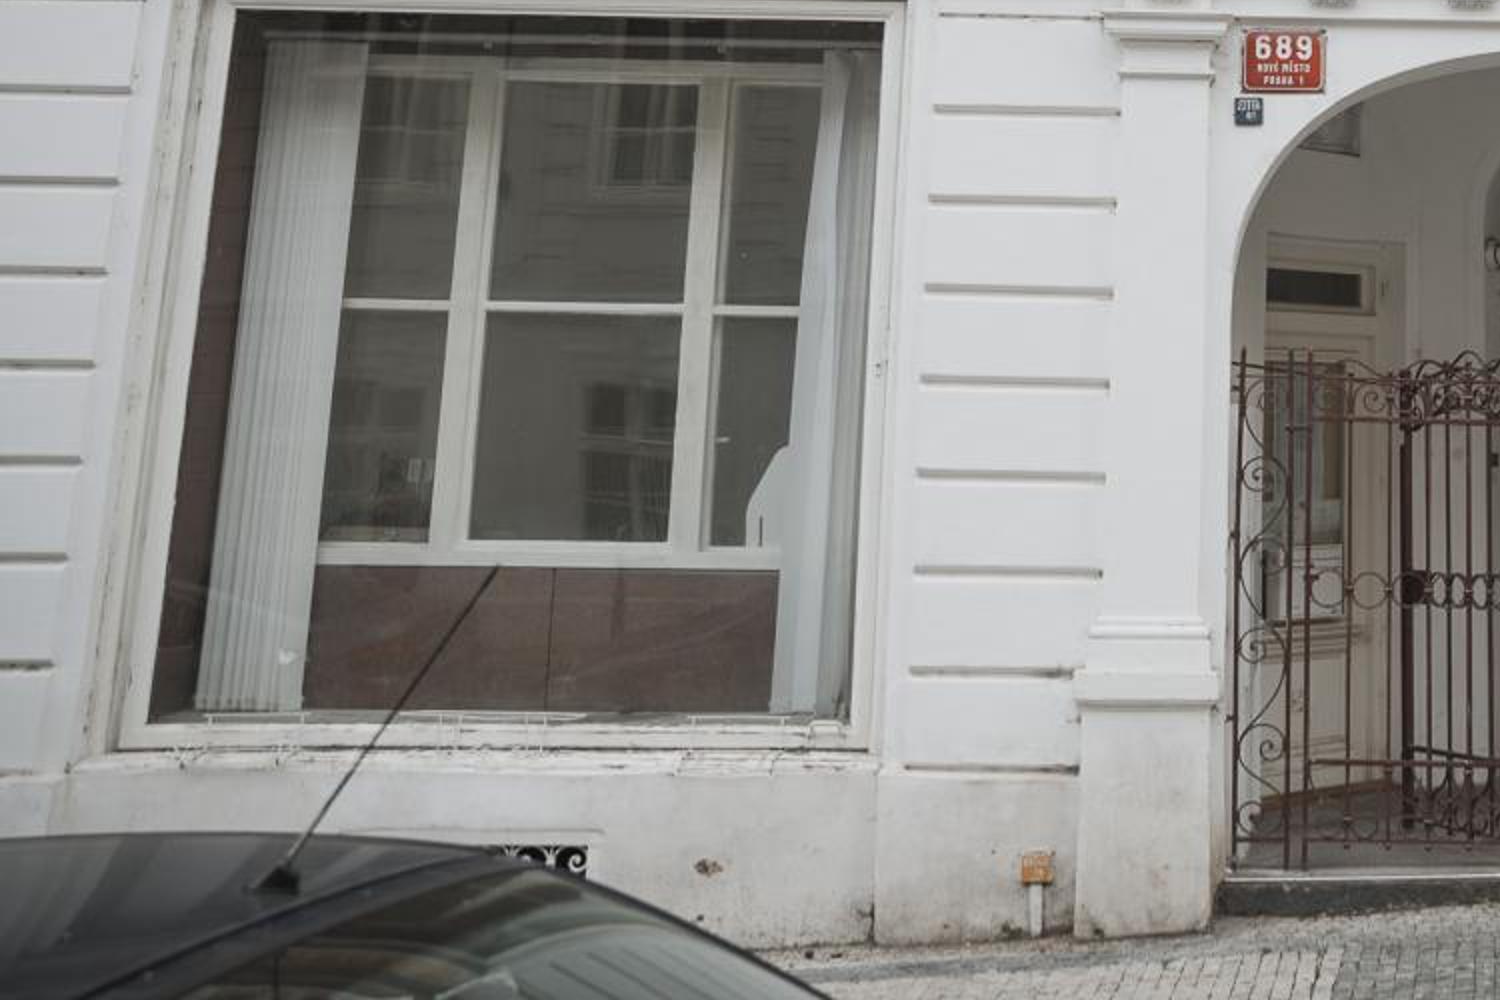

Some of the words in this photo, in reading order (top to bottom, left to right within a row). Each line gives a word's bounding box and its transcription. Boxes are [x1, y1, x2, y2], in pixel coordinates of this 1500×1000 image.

[1255, 34, 1313, 60] 689
[1263, 74, 1294, 85] PRAHA
[1299, 74, 1304, 86] 1
